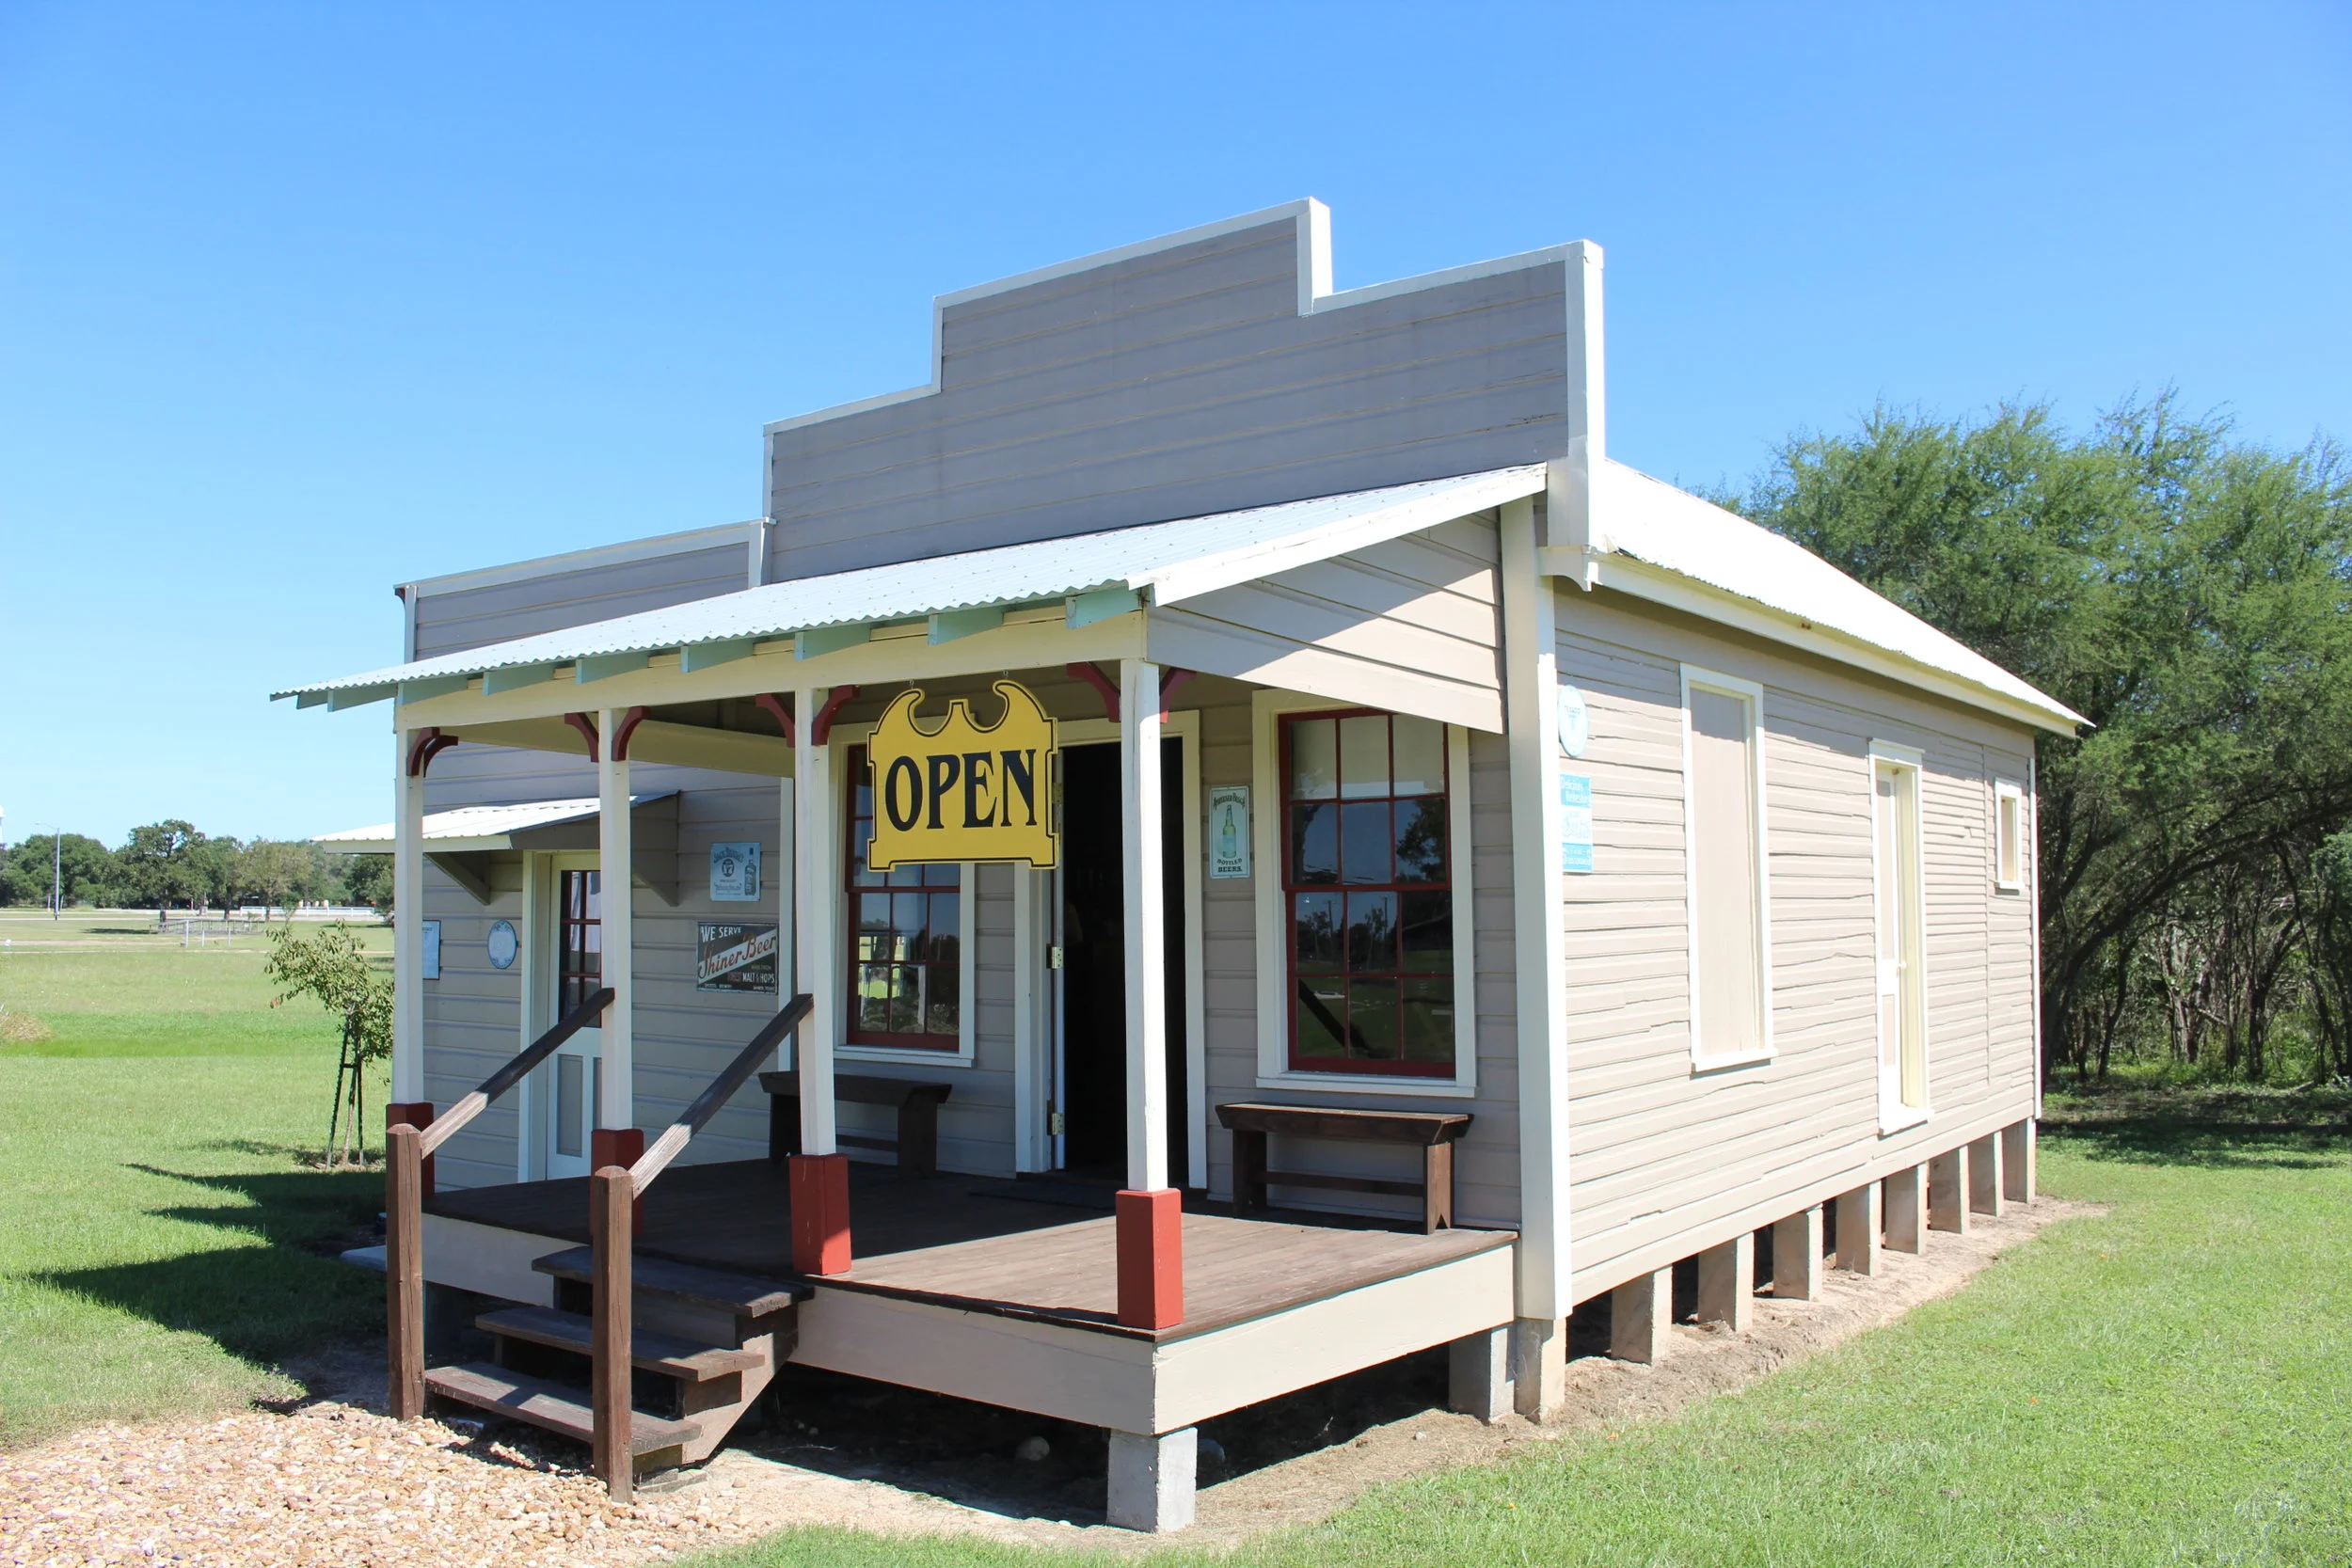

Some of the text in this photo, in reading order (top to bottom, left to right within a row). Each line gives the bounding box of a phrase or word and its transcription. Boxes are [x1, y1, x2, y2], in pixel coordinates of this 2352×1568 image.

[884, 749, 1038, 832] OPEN
[701, 926, 741, 942] WE SERVE
[698, 933, 776, 979] Shiner Beer
[742, 972, 755, 983] MALT
[759, 973, 775, 984] HOPS
